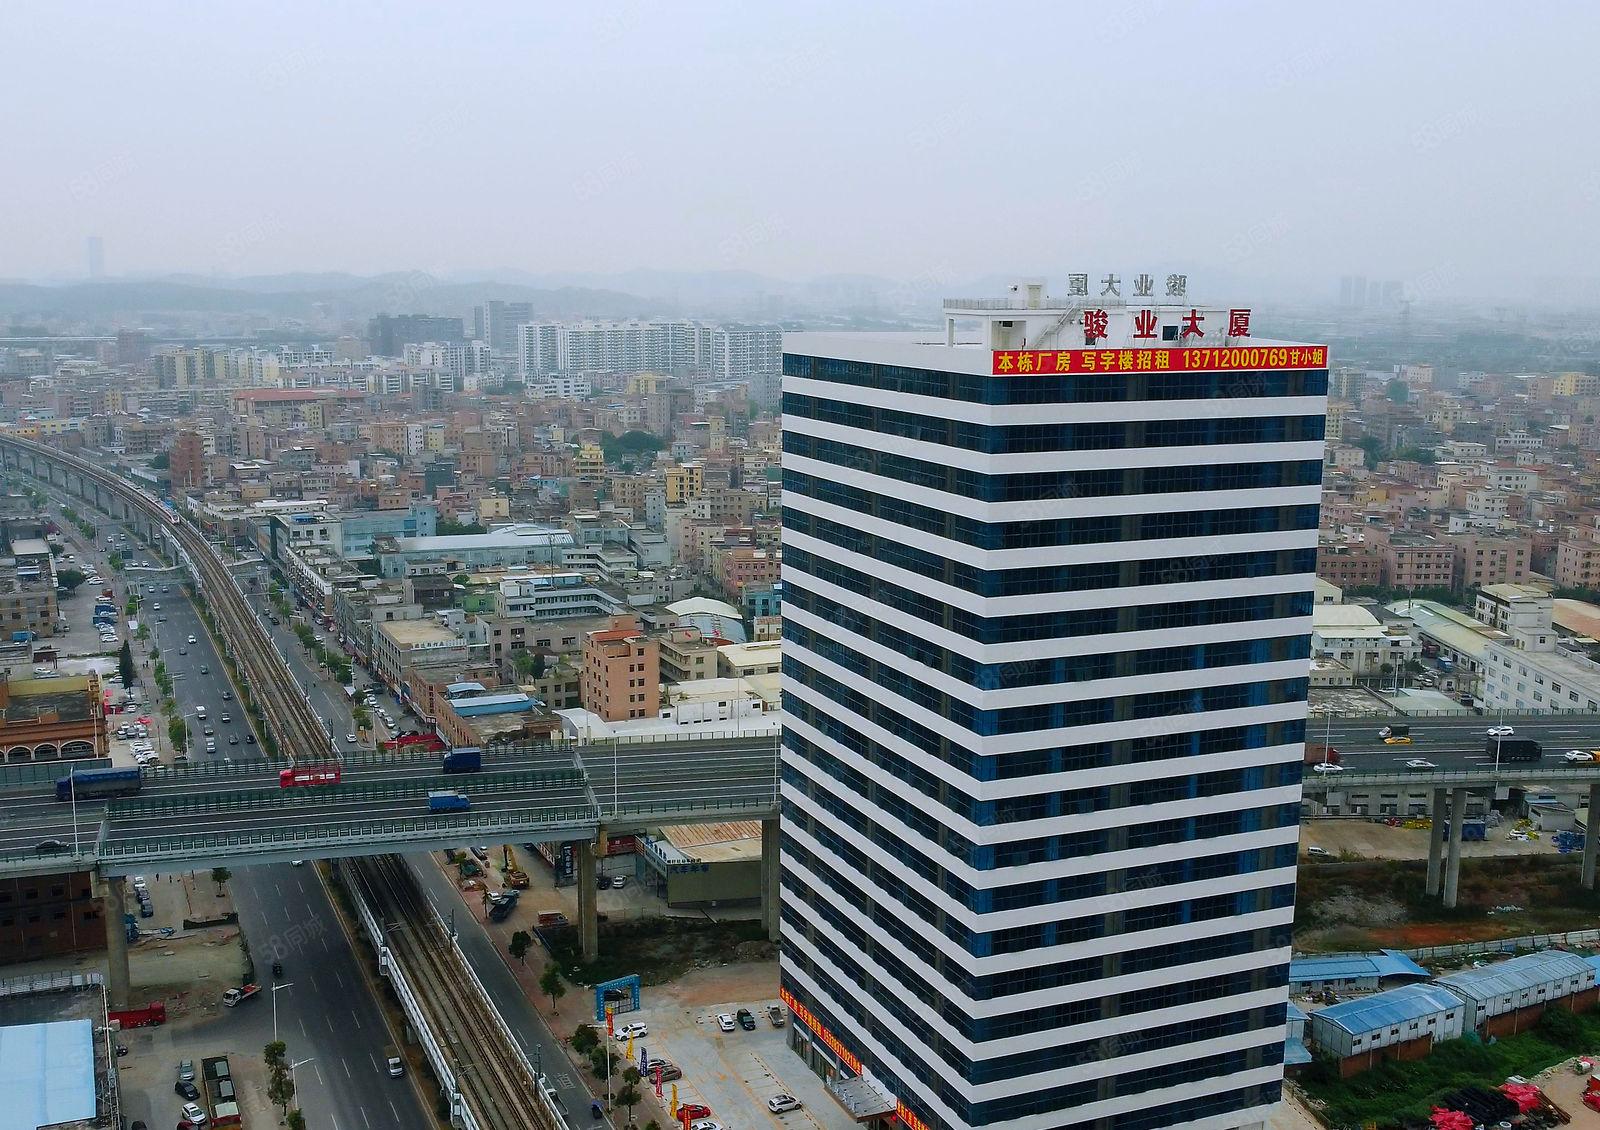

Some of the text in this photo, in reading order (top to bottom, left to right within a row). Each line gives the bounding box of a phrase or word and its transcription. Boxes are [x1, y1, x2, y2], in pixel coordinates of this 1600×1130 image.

[1084, 309, 1251, 339] 骏业大厦
[998, 348, 1323, 372] 本栋厂房 写字楼招租 13712000769 甘小姐
